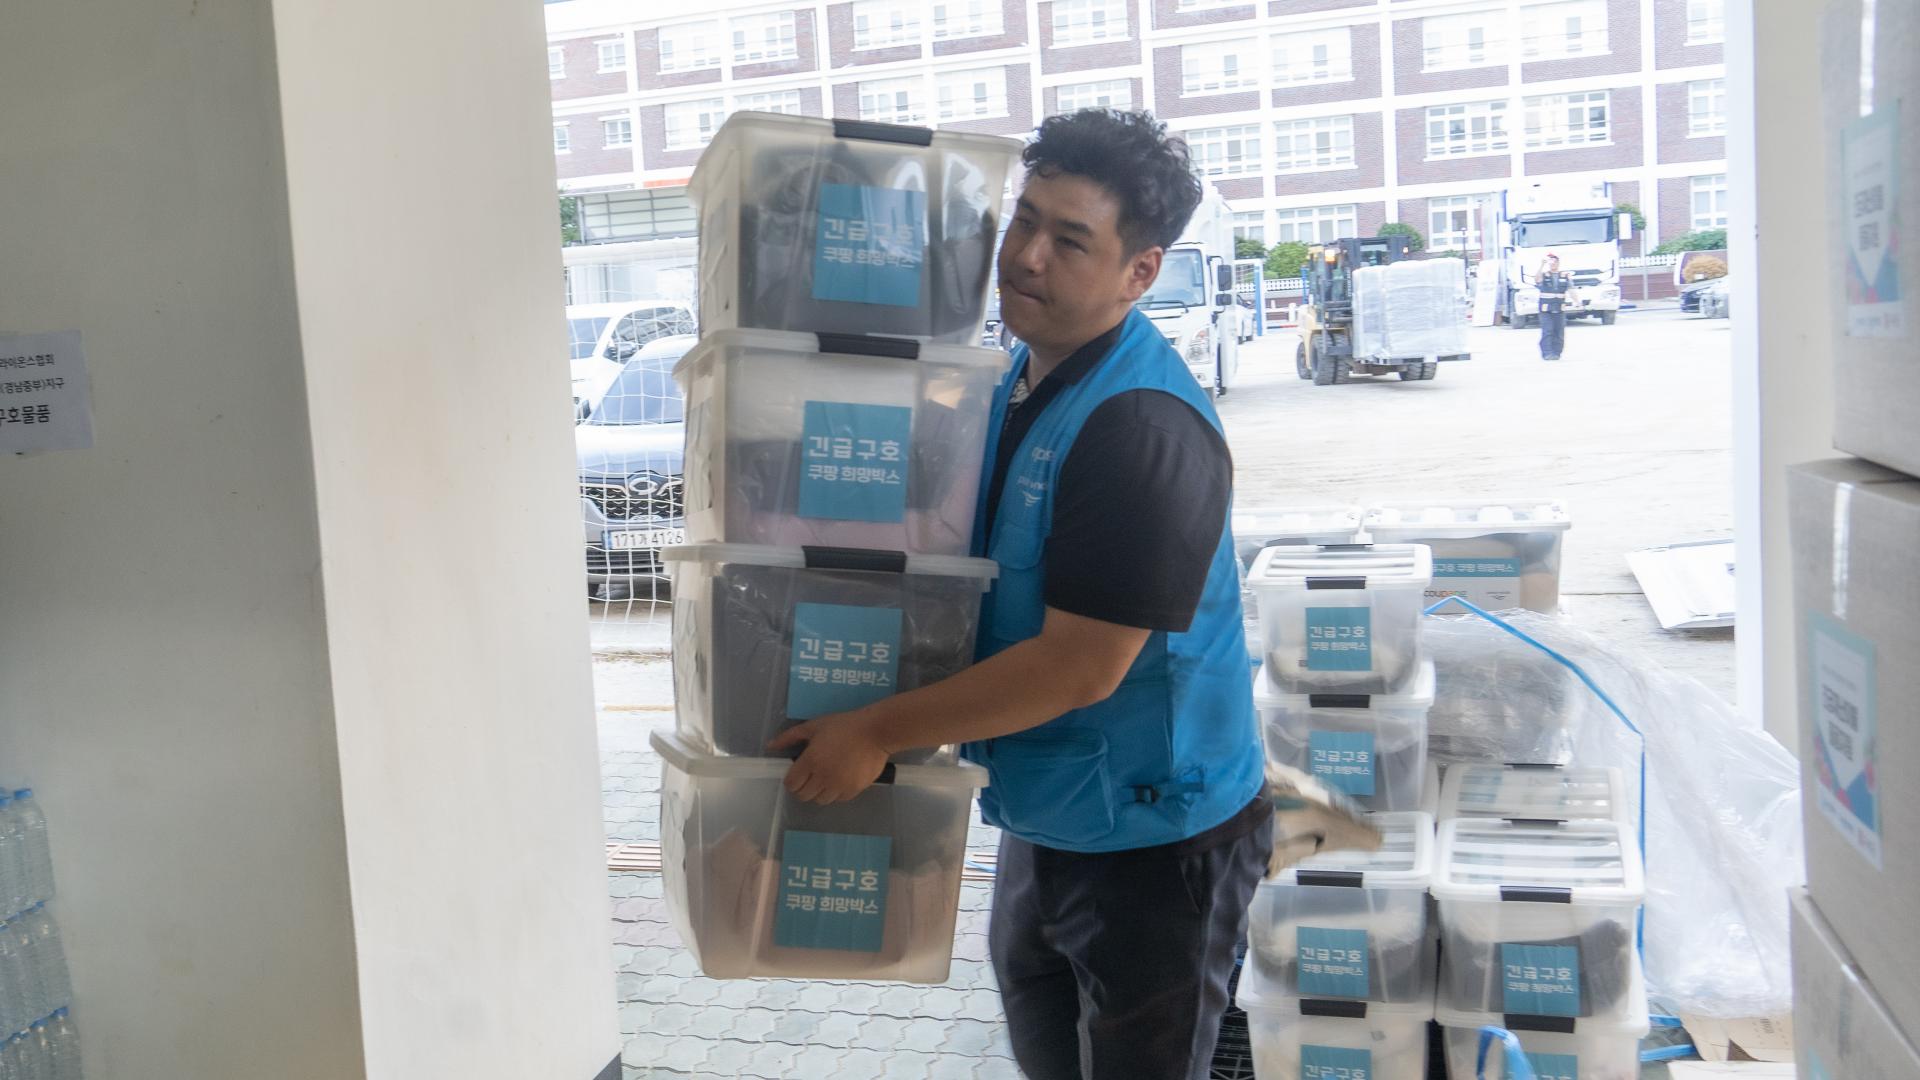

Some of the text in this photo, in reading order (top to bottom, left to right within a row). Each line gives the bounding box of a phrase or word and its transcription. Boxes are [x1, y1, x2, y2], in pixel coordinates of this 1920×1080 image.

[824, 218, 914, 245] 긴급구호
[823, 246, 915, 269] 쿠팡 희망박스
[808, 436, 900, 461] 긴급구호
[807, 464, 900, 485] 쿠팡 희망박스
[1431, 563, 1456, 573] 구호
[1309, 626, 1367, 639] 긴급구호
[799, 638, 891, 663] 긴급구호
[798, 666, 891, 687] 쿠팡 희망박스
[1311, 749, 1369, 763] 긴급구호
[786, 866, 879, 891] 긴급구호
[785, 894, 879, 914] 쿠팡 희망박스
[1301, 947, 1362, 963] 긴급구호
[1506, 965, 1573, 980] 긴급구호
